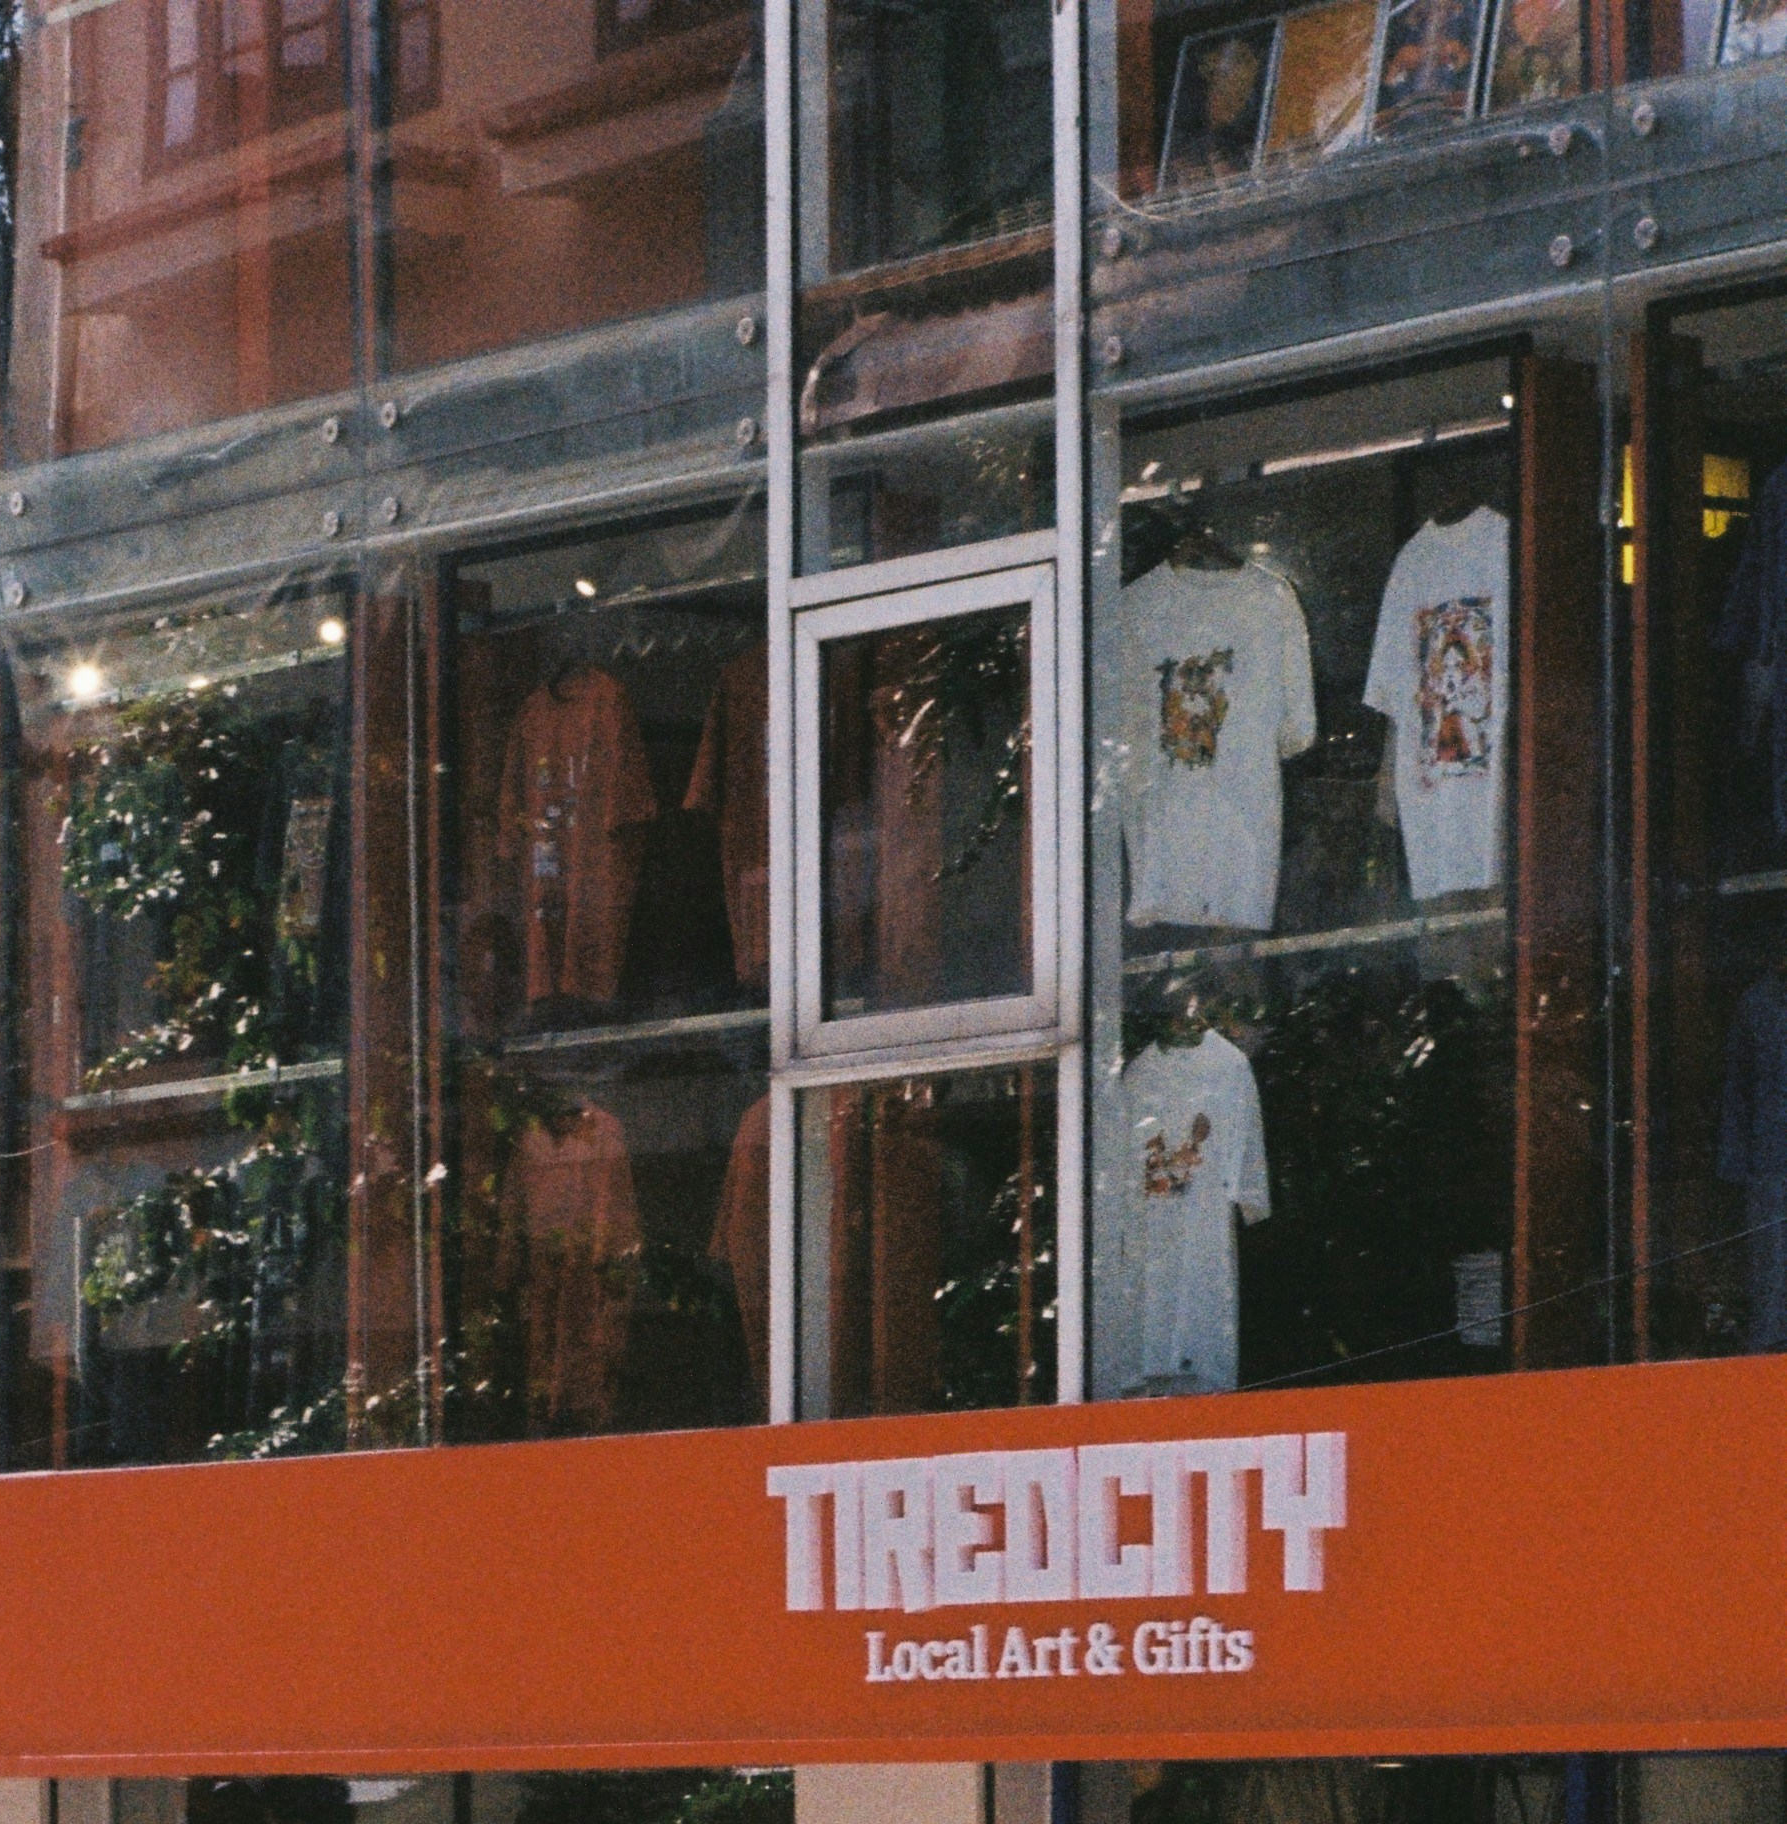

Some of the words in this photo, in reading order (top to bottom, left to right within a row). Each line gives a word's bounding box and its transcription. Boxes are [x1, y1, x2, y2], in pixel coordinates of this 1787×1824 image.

[864, 1625, 988, 1682] Local
[996, 1626, 1080, 1679] Art
[1085, 1623, 1123, 1677] &
[1133, 1616, 1254, 1675] Gifts
